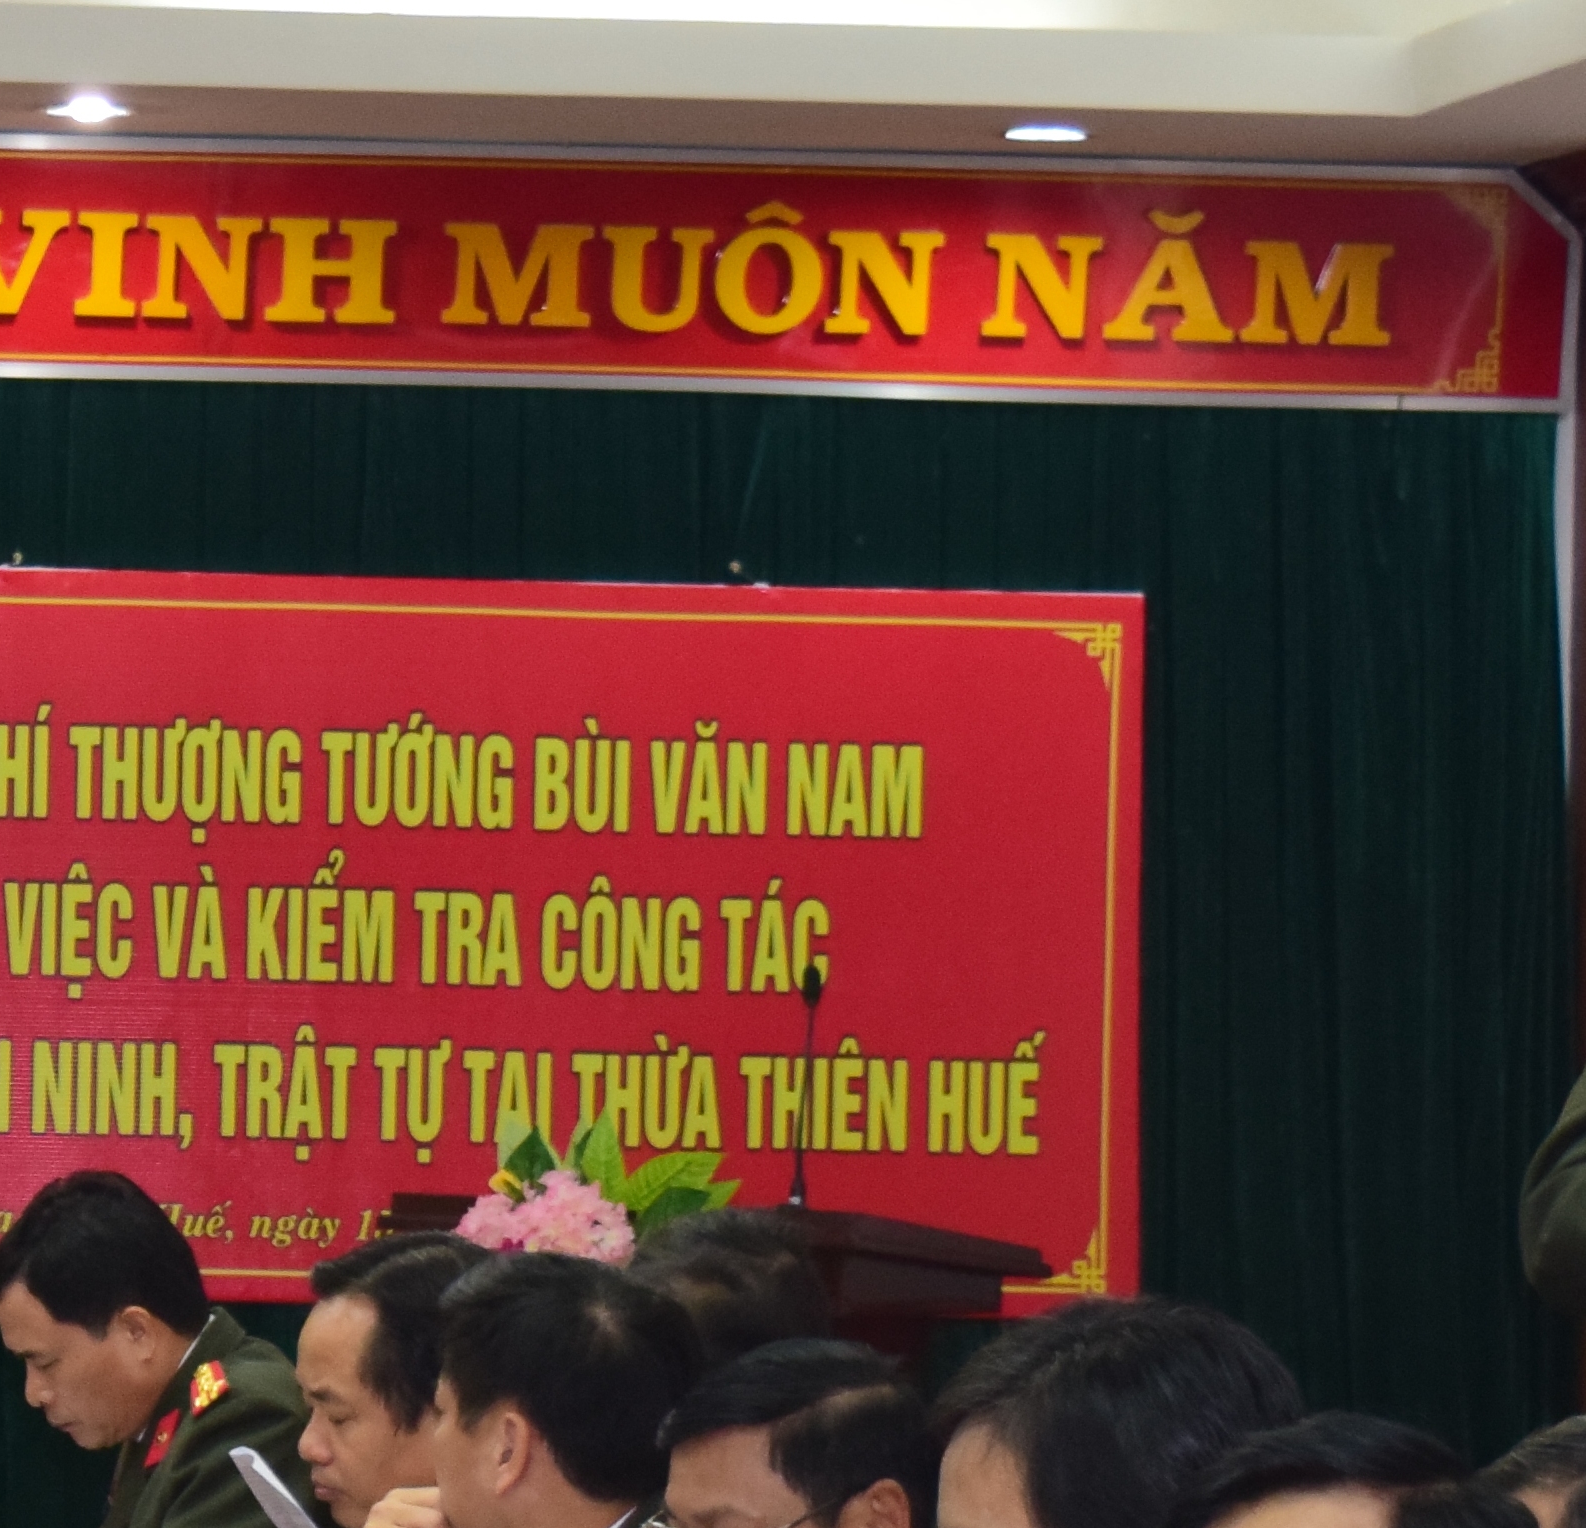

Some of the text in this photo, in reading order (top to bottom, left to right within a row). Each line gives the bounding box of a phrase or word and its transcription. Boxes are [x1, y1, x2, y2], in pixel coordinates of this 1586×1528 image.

[440, 201, 980, 338] MUÔN
[981, 210, 1394, 347] NĂM
[69, 717, 302, 844] THƯỢNG
[321, 712, 515, 830] TƯỚNG
[533, 717, 632, 833] BÙI
[650, 721, 769, 836] VĂN
[786, 741, 925, 839] NAM
[4, 862, 133, 999] VIỆC
[152, 864, 227, 980] VÀ
[246, 848, 396, 983] KIỂM
[414, 890, 522, 987] TRA
[541, 875, 702, 993] CÔNG
[720, 878, 830, 993] TÁC
[31, 1040, 194, 1149] NINH,
[213, 1024, 359, 1162] TRẬT
[374, 1038, 453, 1164] TỰ
[571, 1033, 722, 1150] THỪA
[739, 1036, 909, 1153] THIÊN
[927, 1030, 1047, 1156] HUẾ
[249, 1205, 341, 1247] ngày
